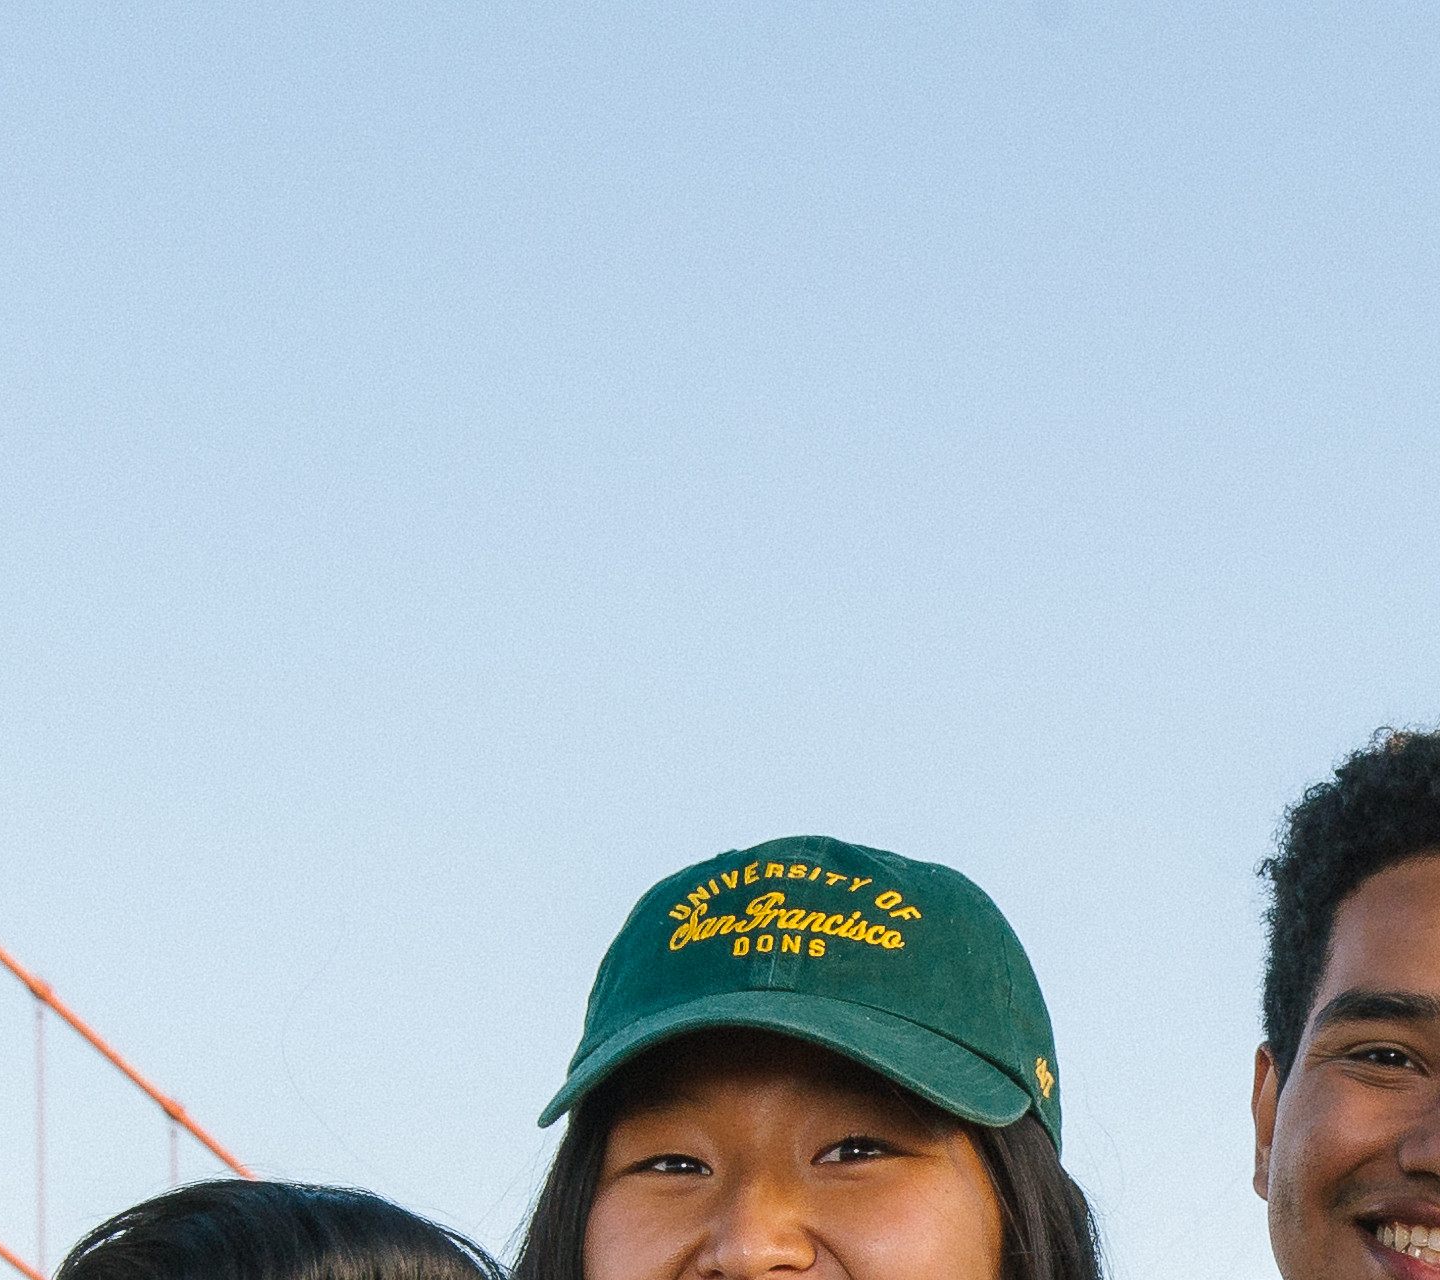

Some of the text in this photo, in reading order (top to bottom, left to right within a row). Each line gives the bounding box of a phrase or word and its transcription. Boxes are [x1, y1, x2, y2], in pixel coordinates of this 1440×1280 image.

[668, 861, 923, 922] UNIVERSITY OF
[669, 891, 905, 951] San Francisco
[732, 933, 827, 958] DONS
